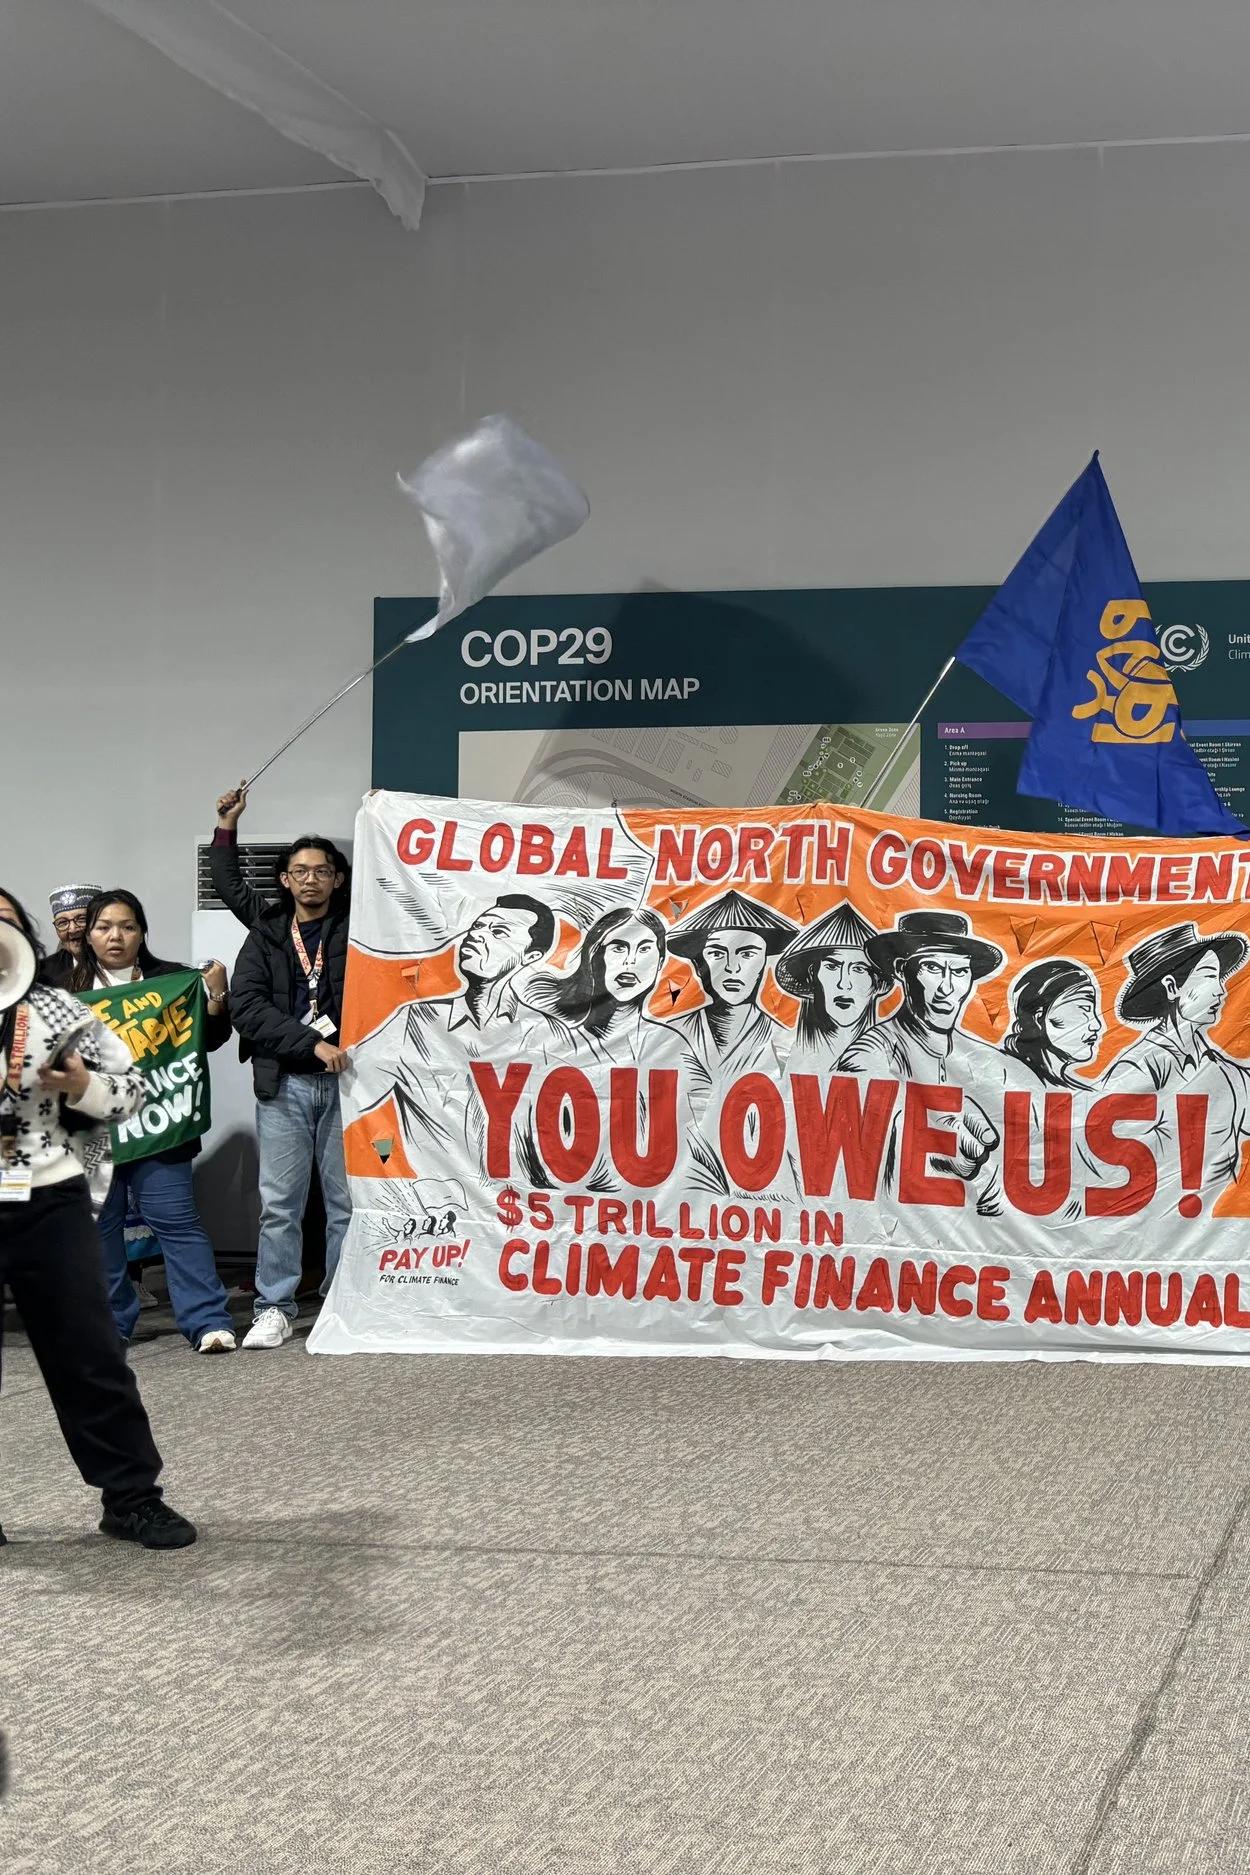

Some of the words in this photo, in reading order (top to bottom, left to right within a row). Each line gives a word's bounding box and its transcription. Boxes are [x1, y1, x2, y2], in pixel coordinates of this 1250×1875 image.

[460, 627, 613, 667] COP29
[460, 679, 633, 705] ORIENTATION
[640, 677, 701, 700] MAP
[396, 819, 627, 881] GLOBAL
[656, 821, 851, 883] NORTH
[115, 995, 194, 1062] TABLE
[122, 991, 163, 1019] AND
[117, 1081, 203, 1143] NOW!
[469, 1061, 679, 1189] YOU
[719, 1072, 966, 1207] OWE
[1003, 1090, 1209, 1218] US!
[563, 1195, 782, 1243] TRILLION
[800, 1210, 843, 1246] IN
[378, 1246, 430, 1271] PAY
[432, 1239, 471, 1268] UP!
[380, 1274, 396, 1284] FOR
[397, 1275, 432, 1285] CLIMATE
[434, 1276, 460, 1286] FINANCE
[499, 1238, 744, 1306] CLIMATE
[761, 1249, 1011, 1321] FINANCE
